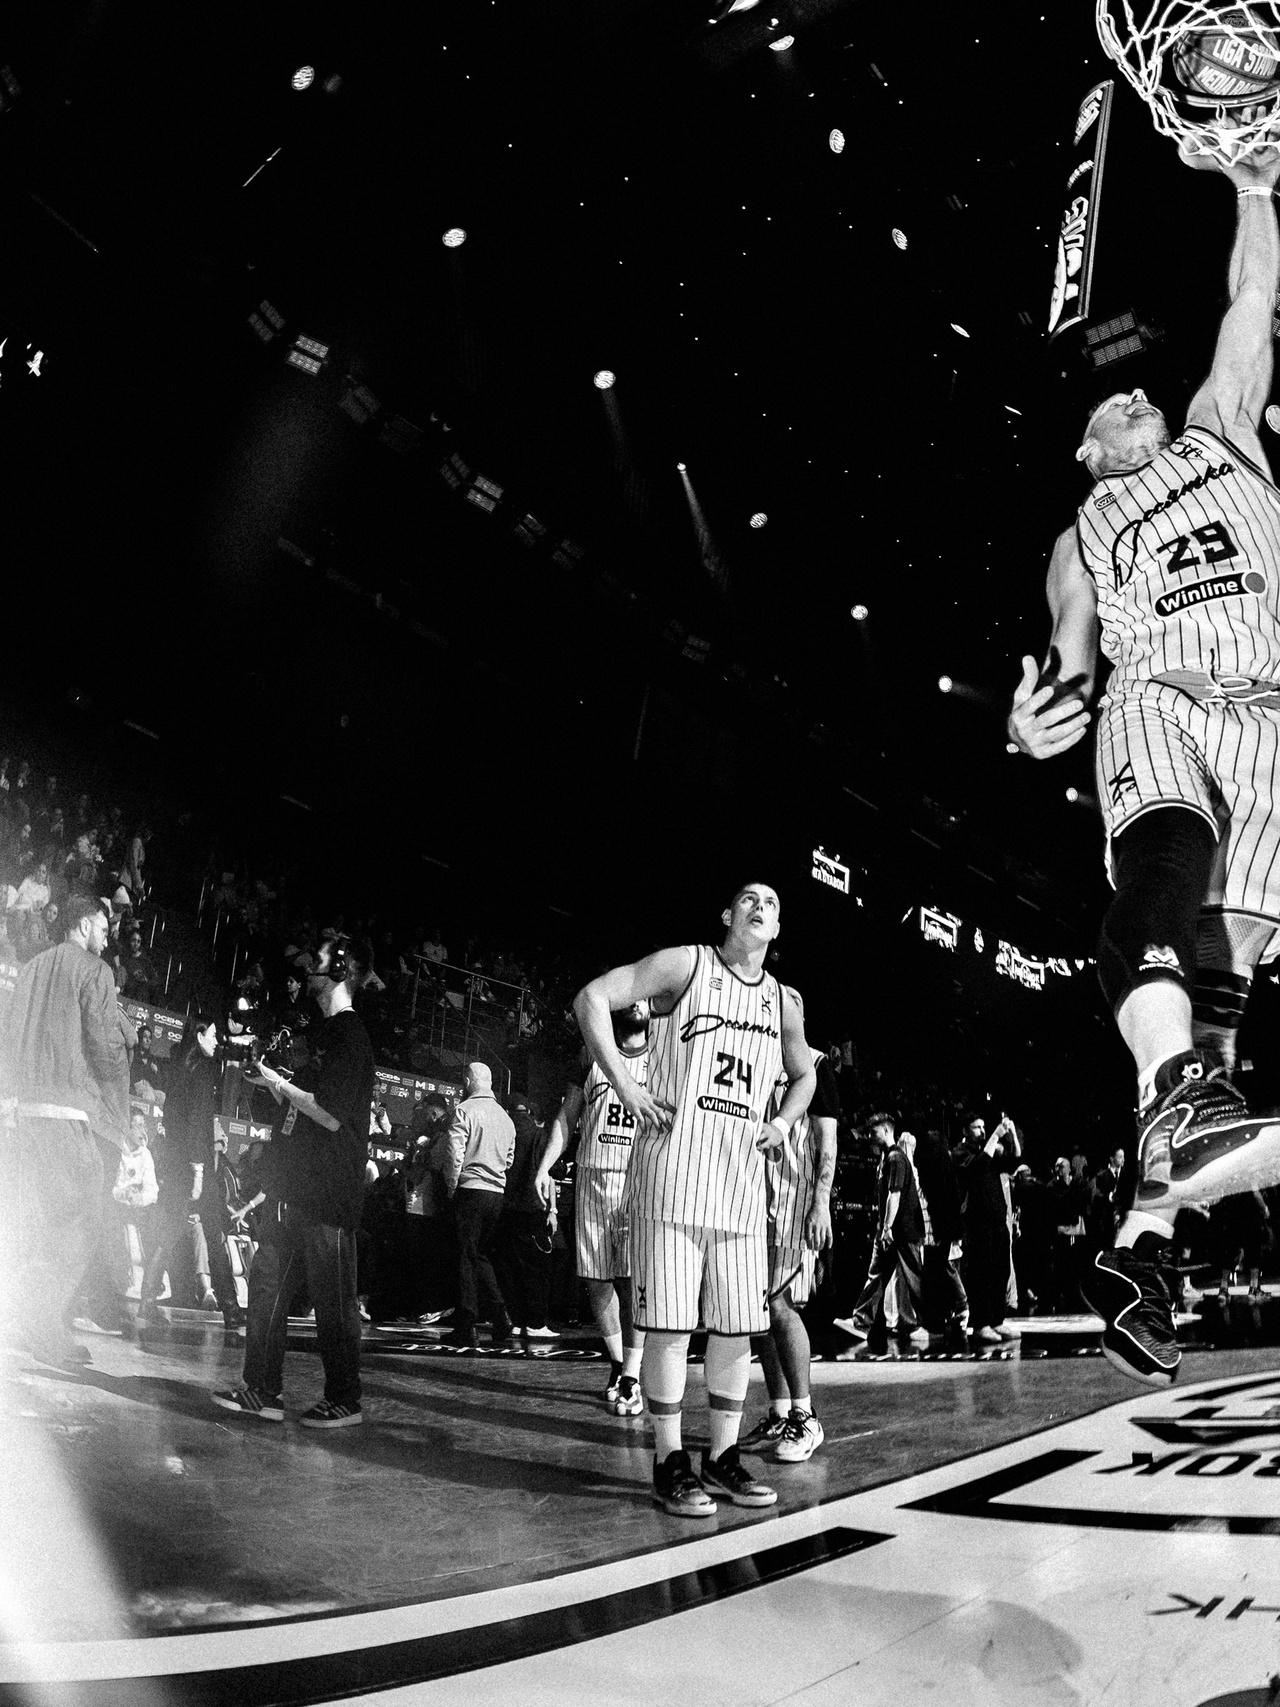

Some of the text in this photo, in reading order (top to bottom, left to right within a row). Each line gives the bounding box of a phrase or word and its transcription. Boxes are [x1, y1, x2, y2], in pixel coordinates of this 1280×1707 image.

[1212, 38, 1246, 69] LIGA
[1196, 65, 1237, 95] MEDIA
[1156, 519, 1239, 575] 29
[1160, 581, 1239, 612] Winline
[713, 1051, 752, 1095] 24
[606, 1103, 635, 1129] 88
[702, 1097, 748, 1118] Winline
